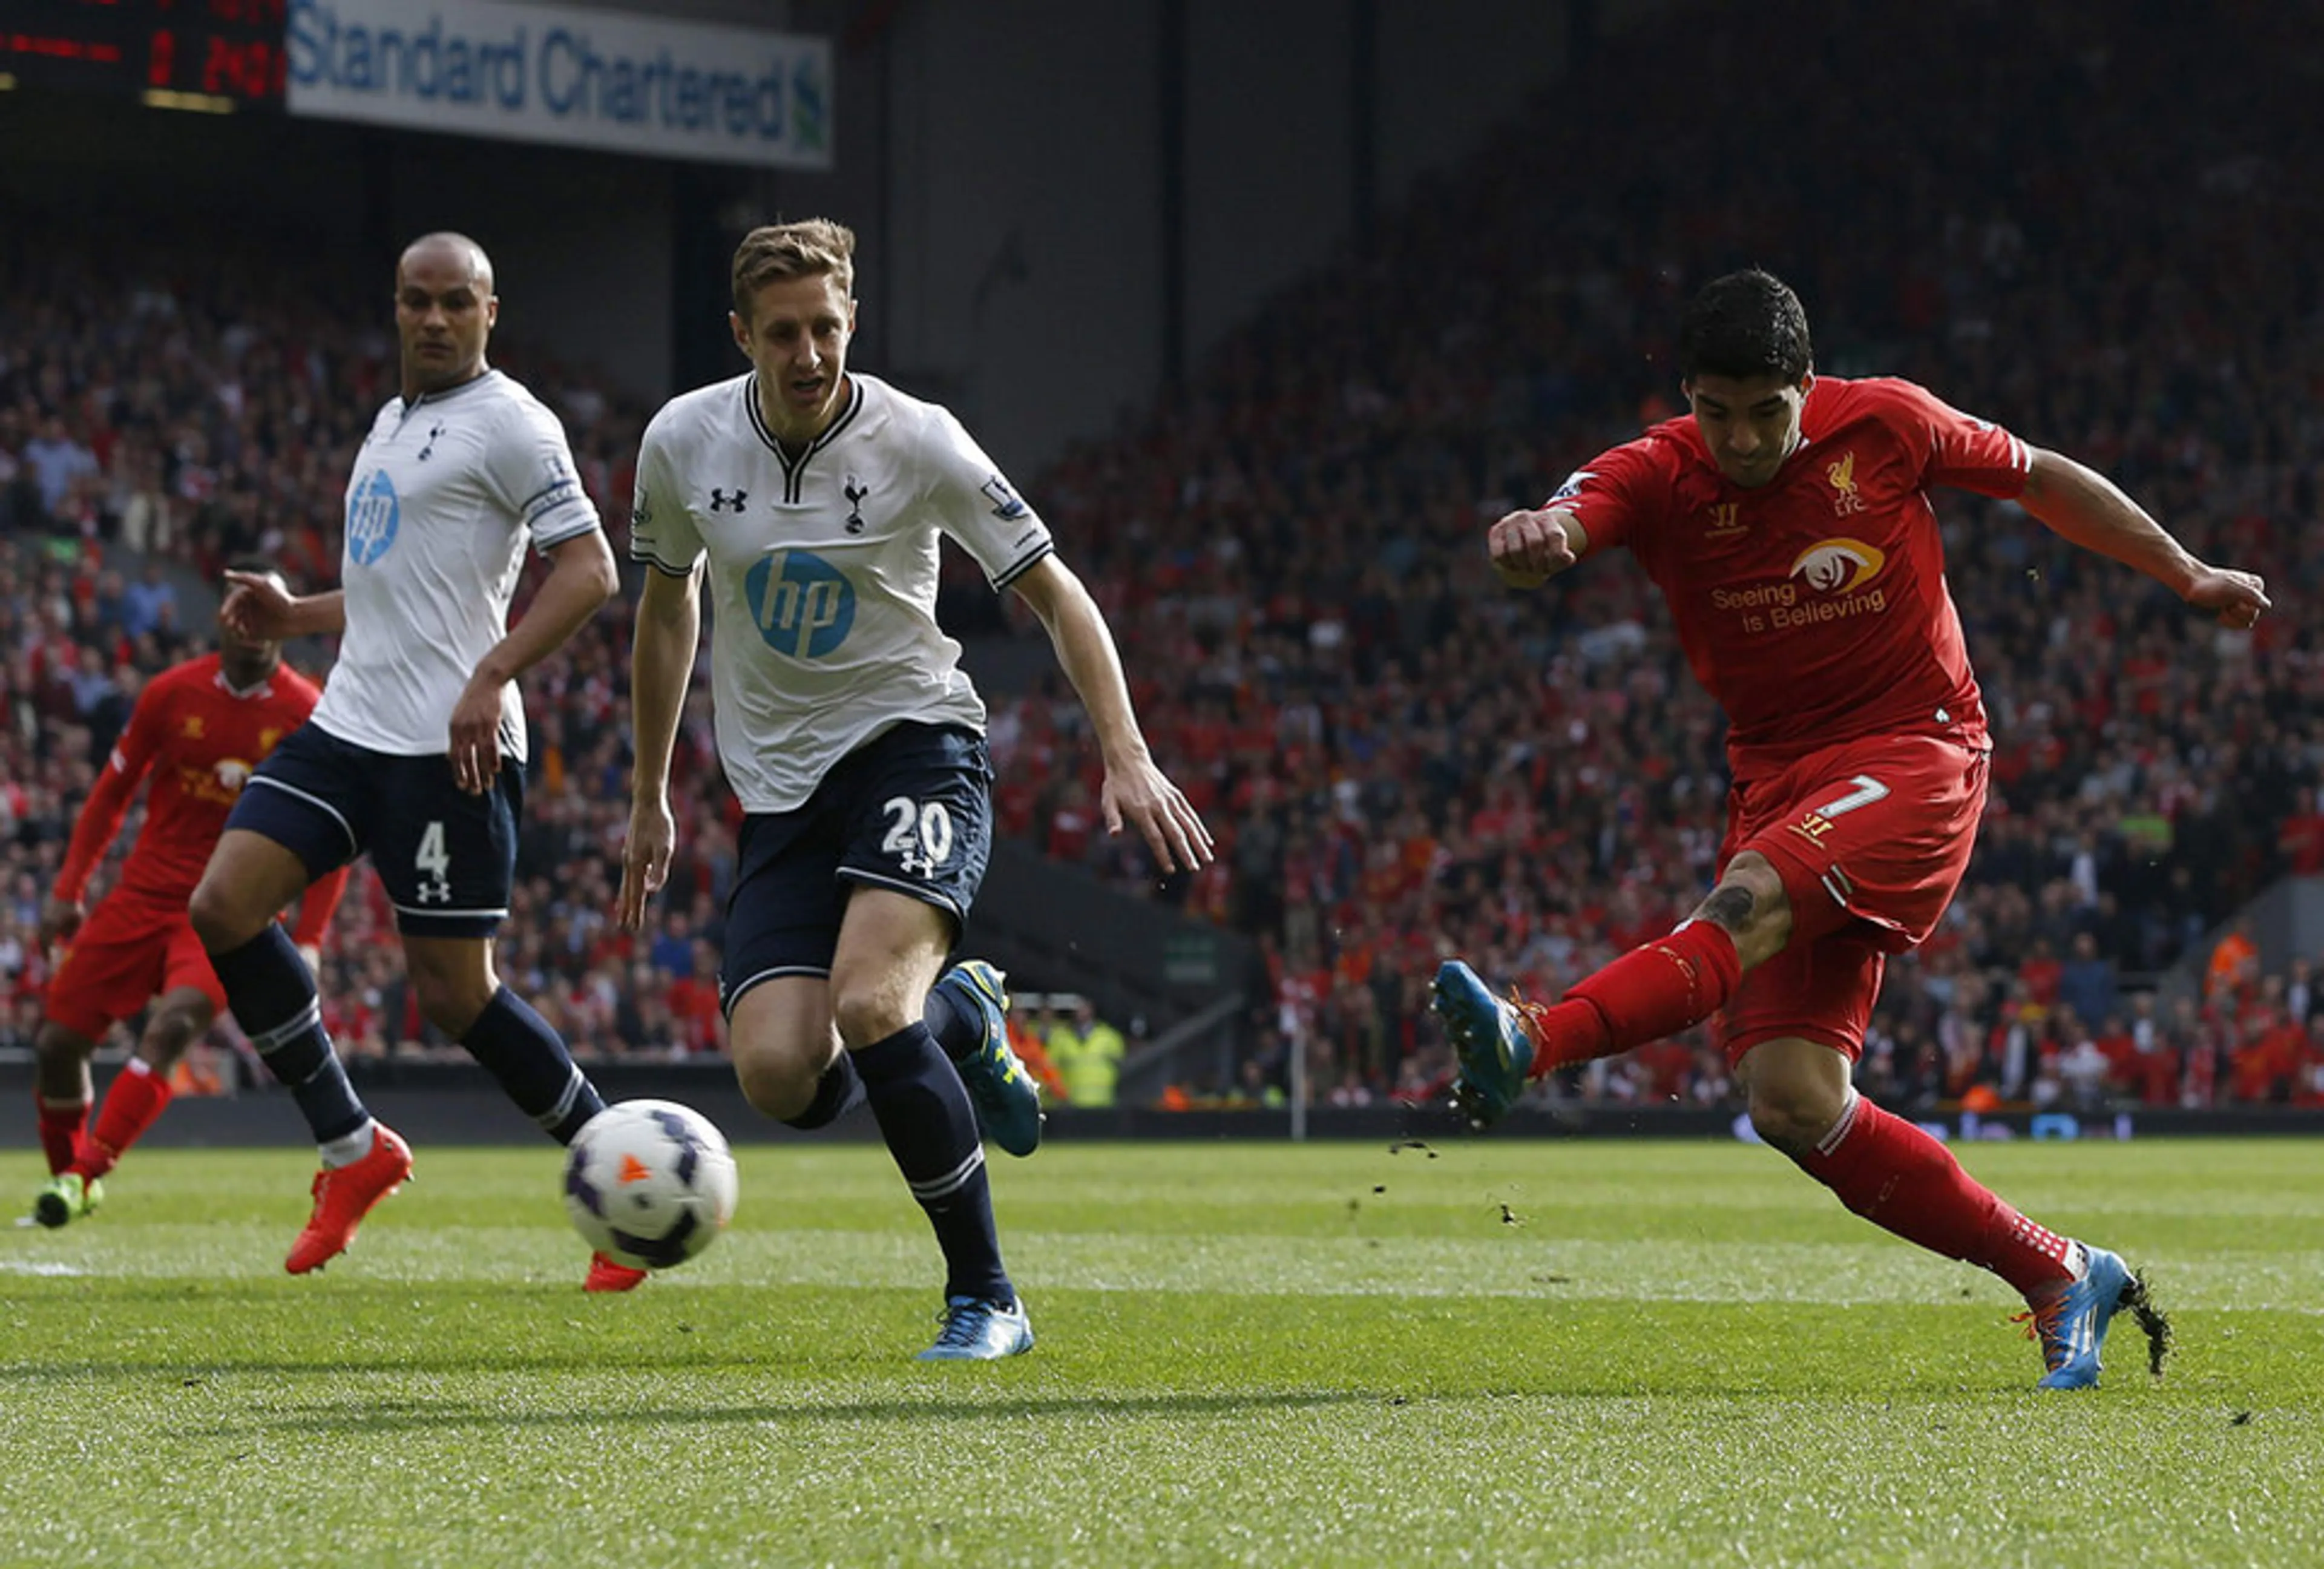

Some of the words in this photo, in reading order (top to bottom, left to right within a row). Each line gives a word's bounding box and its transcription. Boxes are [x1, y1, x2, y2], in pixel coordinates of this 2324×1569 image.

[287, 0, 525, 111] Standard
[538, 27, 784, 141] Chartered
[761, 552, 842, 659] hp
[1711, 584, 1796, 609] Seeing
[1770, 587, 1886, 629] Believing
[1816, 774, 1891, 818] 7
[415, 821, 451, 883] 4
[882, 796, 953, 864] 20
